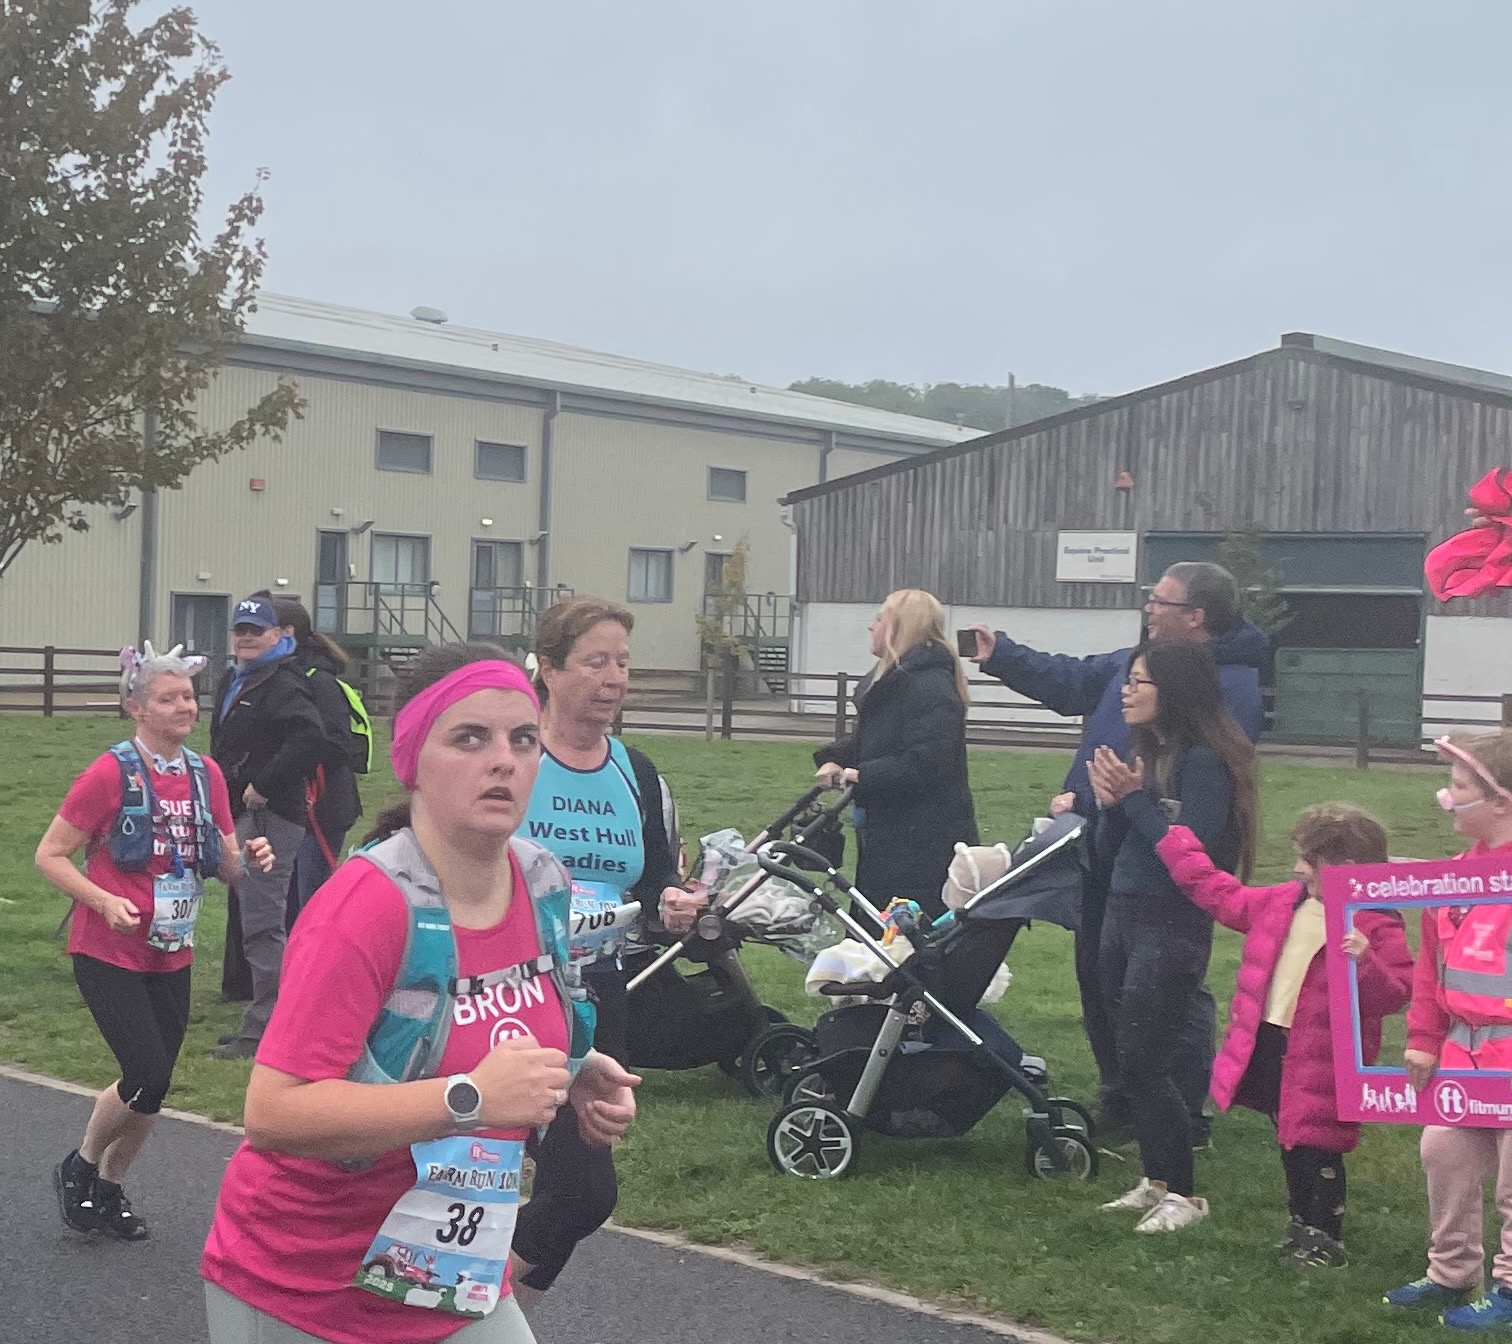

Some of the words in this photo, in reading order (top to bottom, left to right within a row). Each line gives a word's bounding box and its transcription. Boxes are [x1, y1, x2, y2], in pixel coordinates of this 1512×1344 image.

[237, 599, 263, 614] NY
[159, 799, 192, 817] SUE
[551, 795, 617, 817] DIANA
[528, 820, 590, 843] West
[595, 826, 637, 848] Hull
[561, 851, 628, 873] adies
[1366, 871, 1485, 898] celebration
[452, 975, 545, 1027] BRON
[1439, 1086, 1464, 1114] ft
[427, 1164, 468, 1188] FARM
[469, 1168, 496, 1190] RUN
[435, 1201, 485, 1247] 38
